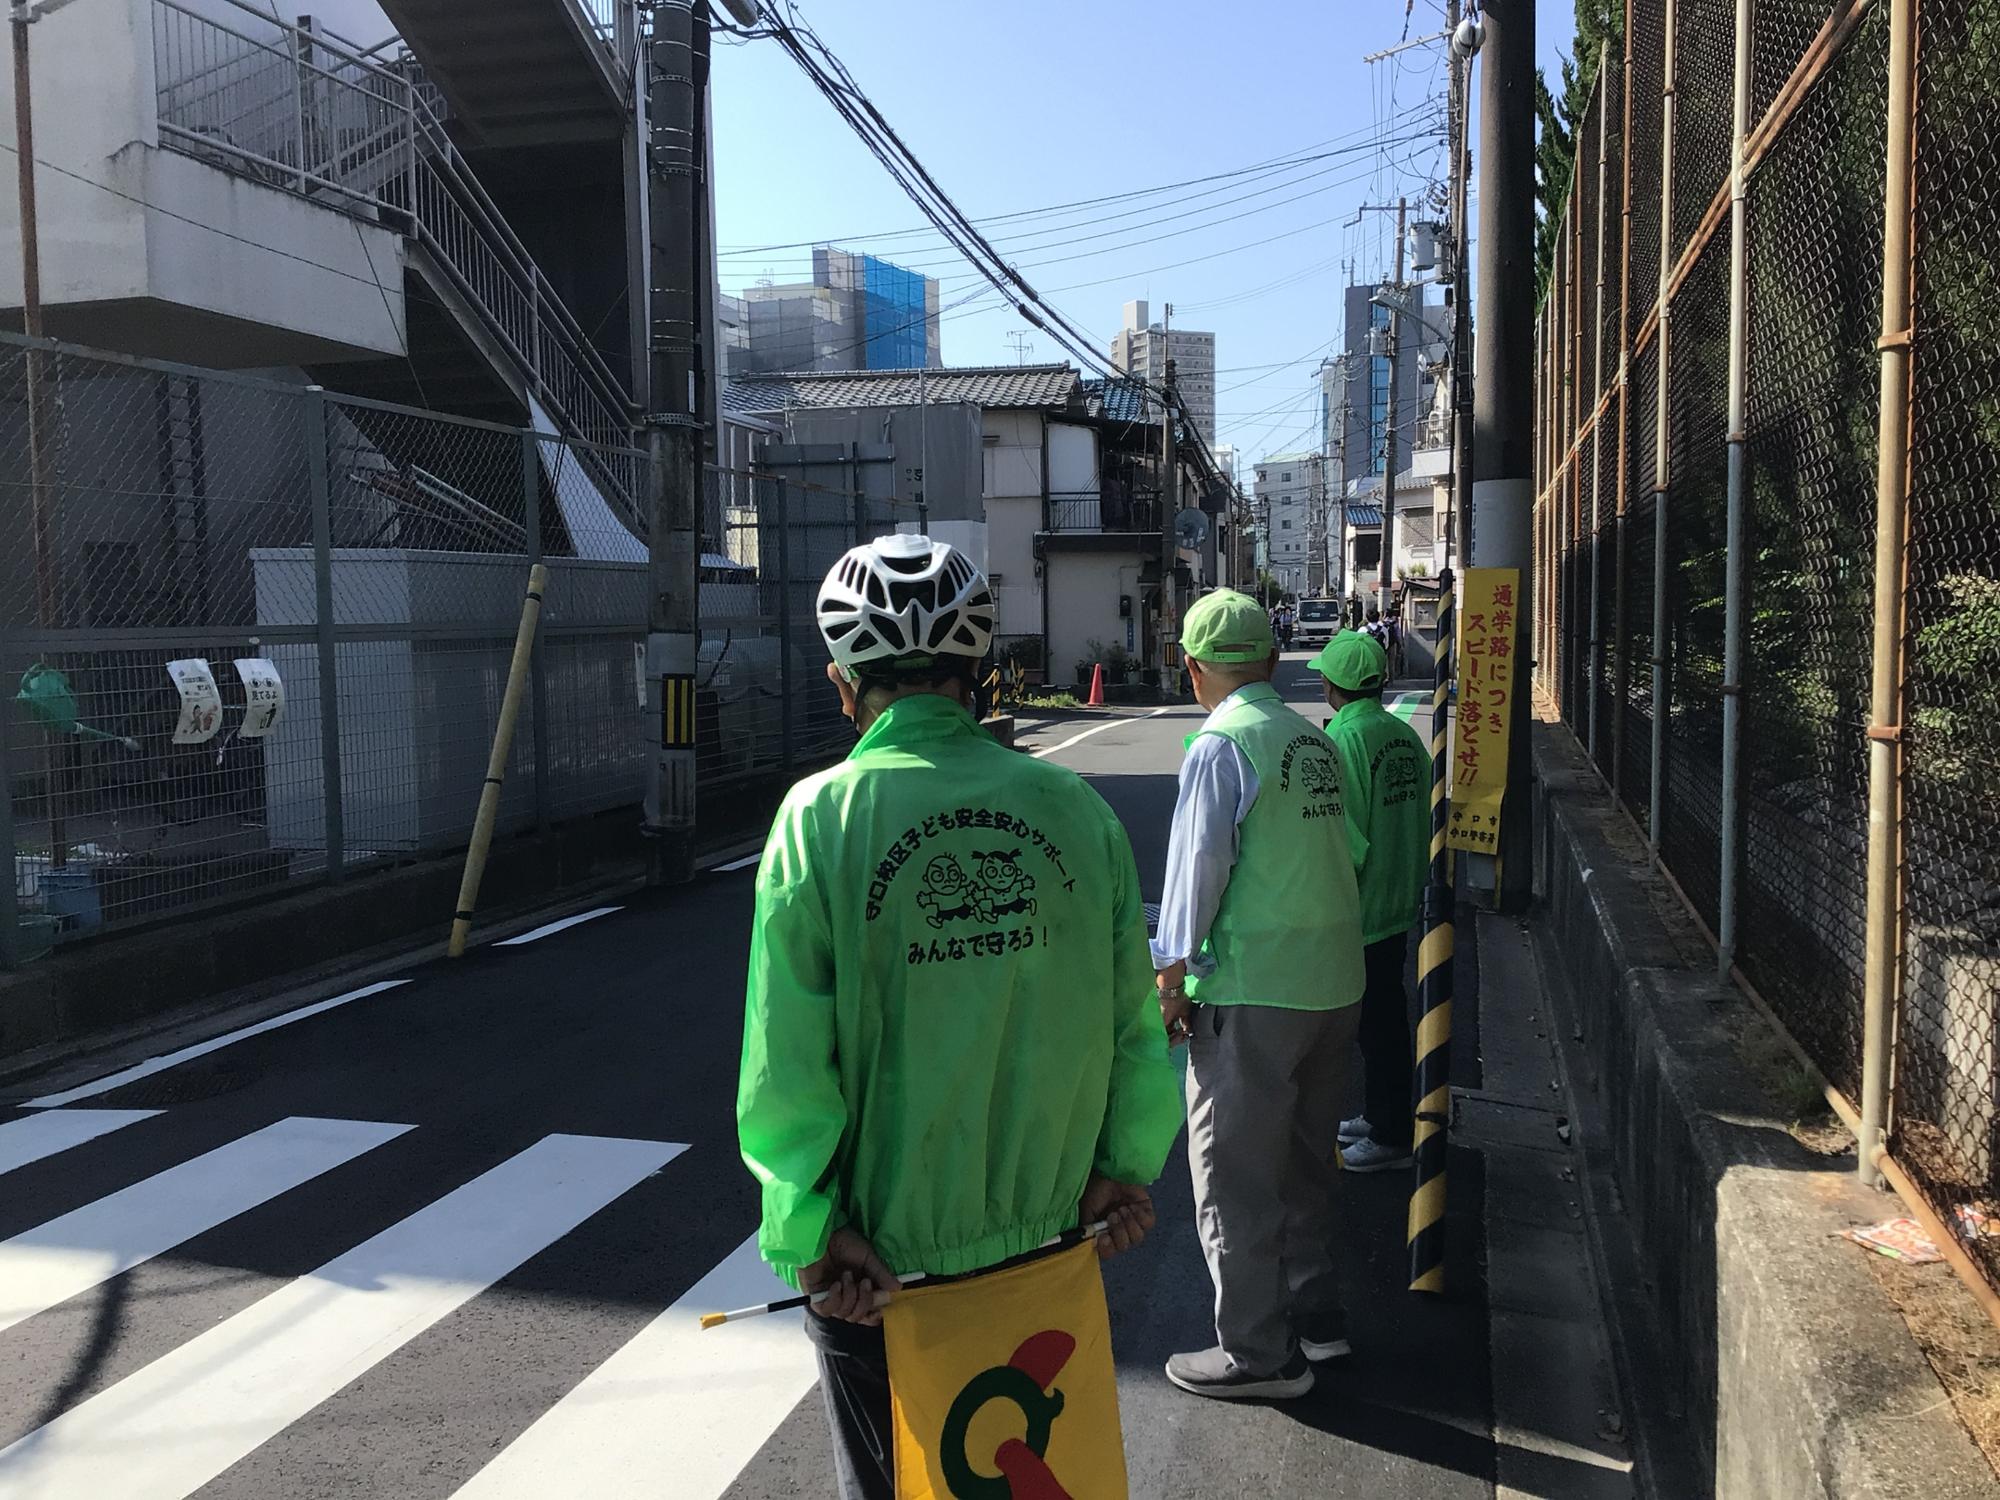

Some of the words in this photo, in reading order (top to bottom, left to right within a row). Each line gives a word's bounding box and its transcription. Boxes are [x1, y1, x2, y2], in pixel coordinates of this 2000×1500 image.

[251, 690, 278, 701] 見てるよ
[1457, 613, 1488, 787] スピード落とせ!!
[1488, 584, 1514, 735] 通学路につき
[865, 808, 1076, 921] 守口校区子ども安全安心サポート
[907, 926, 1048, 965] みんなで守ろう!
